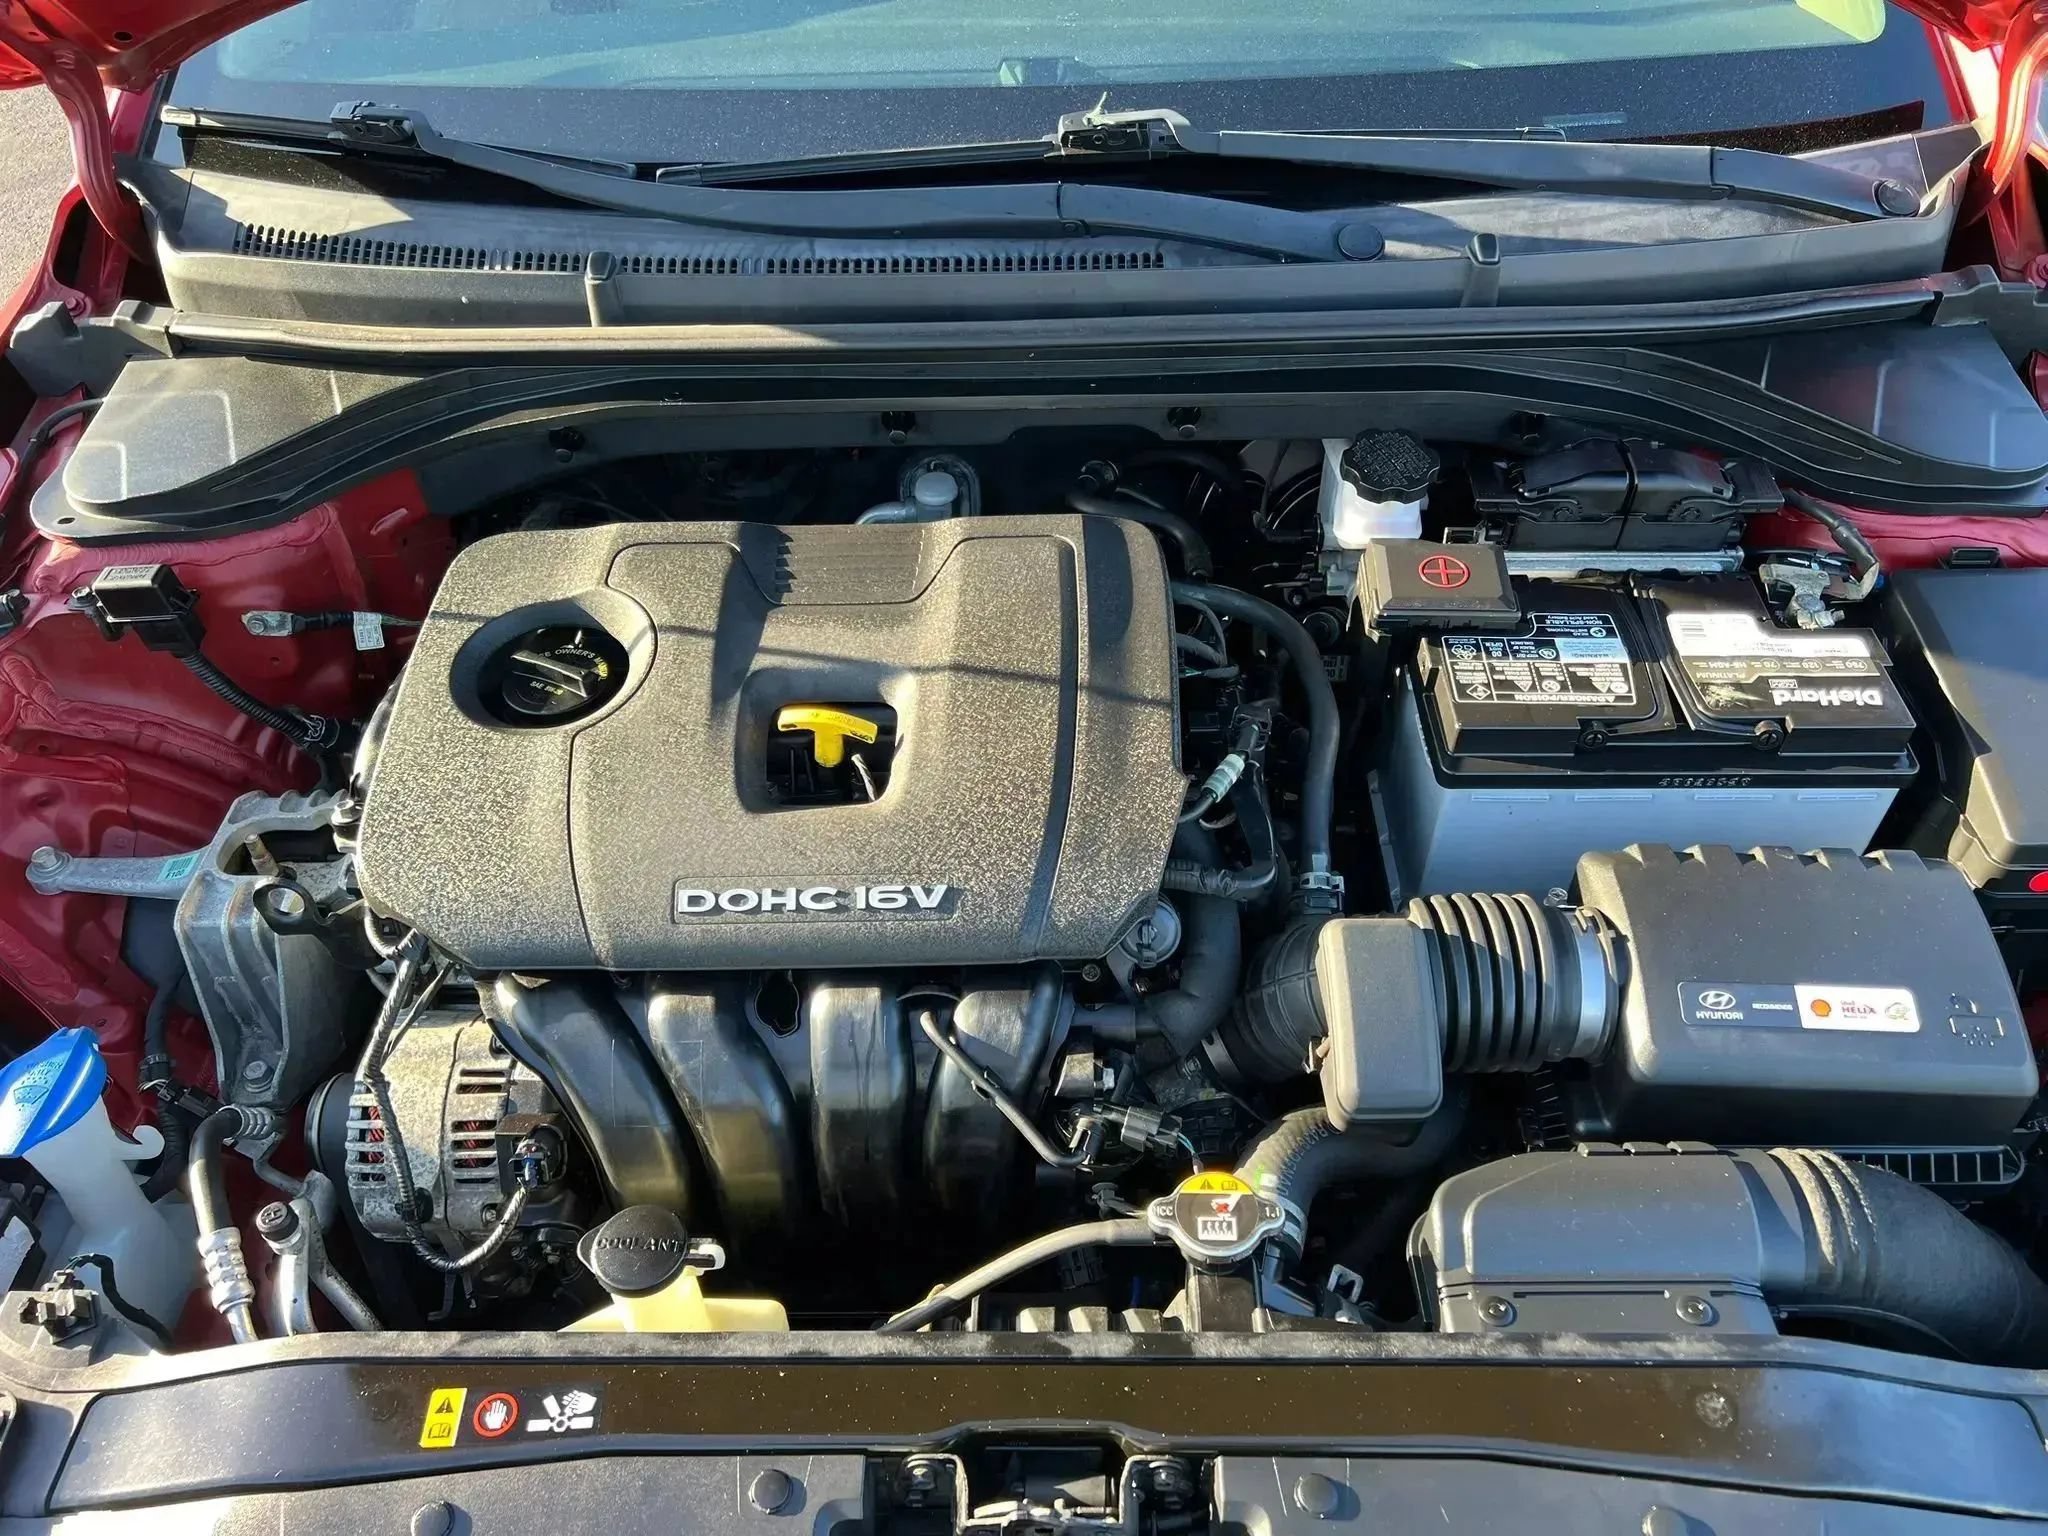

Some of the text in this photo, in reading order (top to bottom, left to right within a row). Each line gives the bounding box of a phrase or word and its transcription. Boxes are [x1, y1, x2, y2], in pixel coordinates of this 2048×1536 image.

[555, 648, 596, 660] OWNER'S
[1771, 688, 1883, 706] DieHard
[678, 884, 948, 914] DOHC 16V
[1696, 1011, 1744, 1020] HYUNDAI
[1841, 1006, 1877, 1014] HELIX
[598, 1237, 679, 1253] COOLANT
